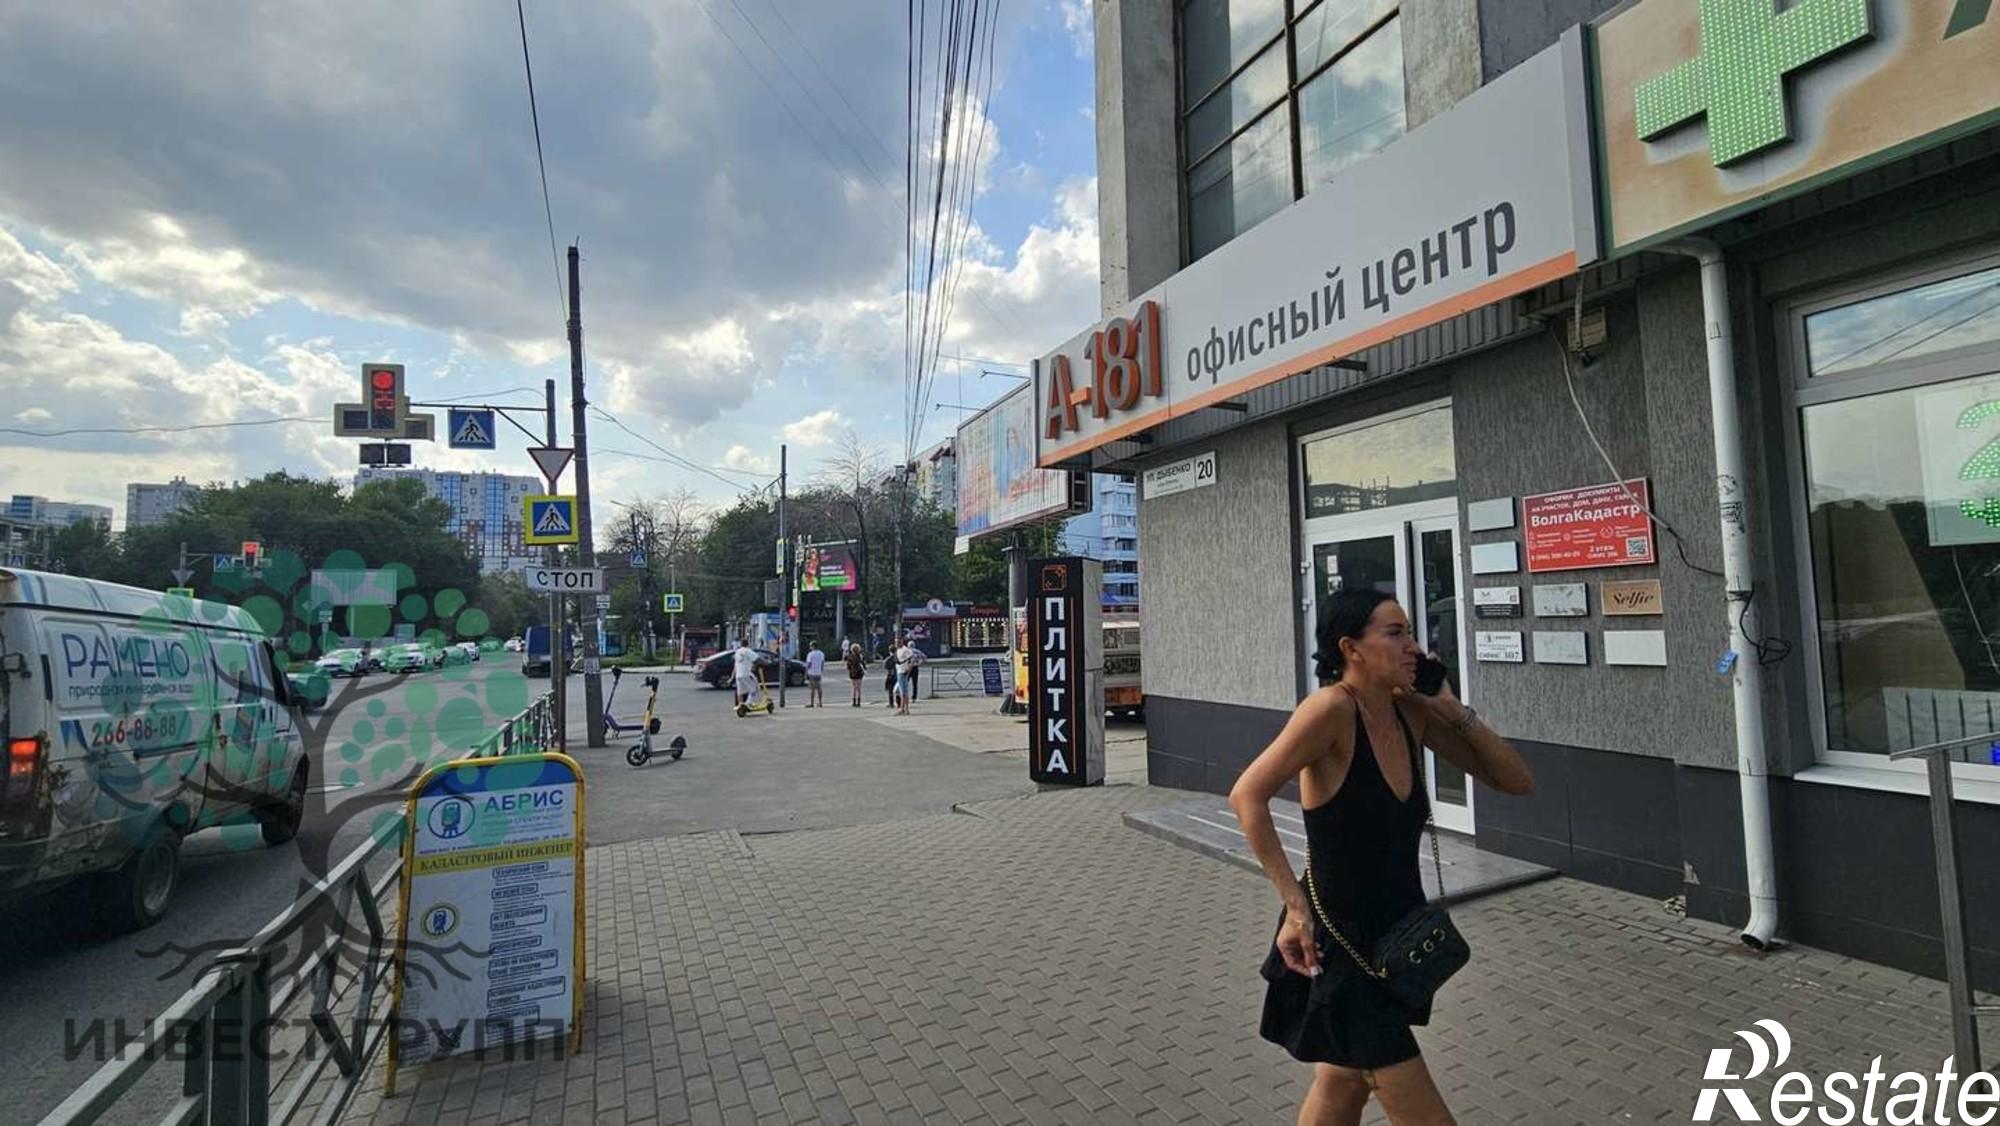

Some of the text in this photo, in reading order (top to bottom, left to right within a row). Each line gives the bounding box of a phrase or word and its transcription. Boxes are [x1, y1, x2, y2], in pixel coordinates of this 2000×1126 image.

[1187, 200, 1516, 384] офисный центр
[1044, 300, 1165, 441] А-181
[1197, 458, 1214, 480] 20
[1530, 504, 1641, 527] ВолгаКадастр
[537, 570, 594, 589] СТОП
[61, 633, 190, 679] РАМЕНО
[68, 684, 123, 700] природная
[1044, 597, 1069, 774] ПЛИТКА
[91, 714, 177, 747] 266-88-88
[483, 789, 564, 814] АБРИС
